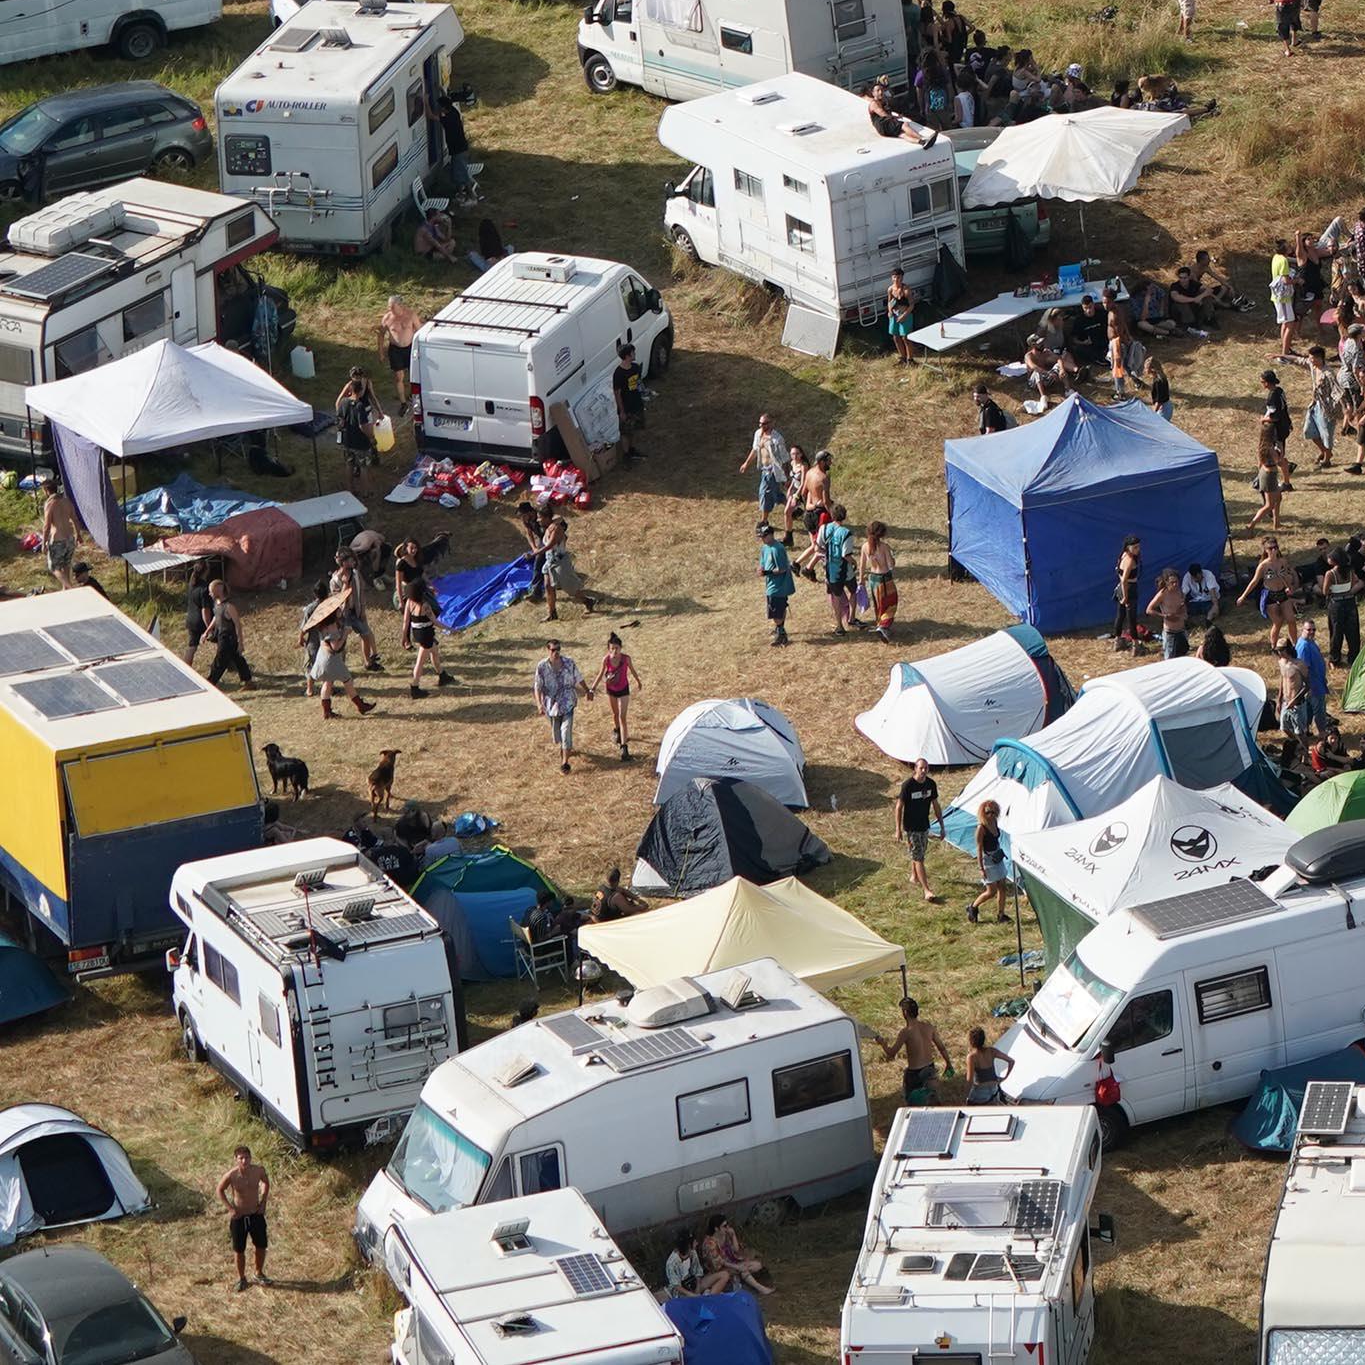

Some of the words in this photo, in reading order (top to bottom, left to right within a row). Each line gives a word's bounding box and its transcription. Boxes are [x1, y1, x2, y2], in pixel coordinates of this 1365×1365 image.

[265, 100, 327, 111] AUTO-ROLLER
[1064, 847, 1101, 875] 24MX
[1174, 857, 1243, 881] 24MX
